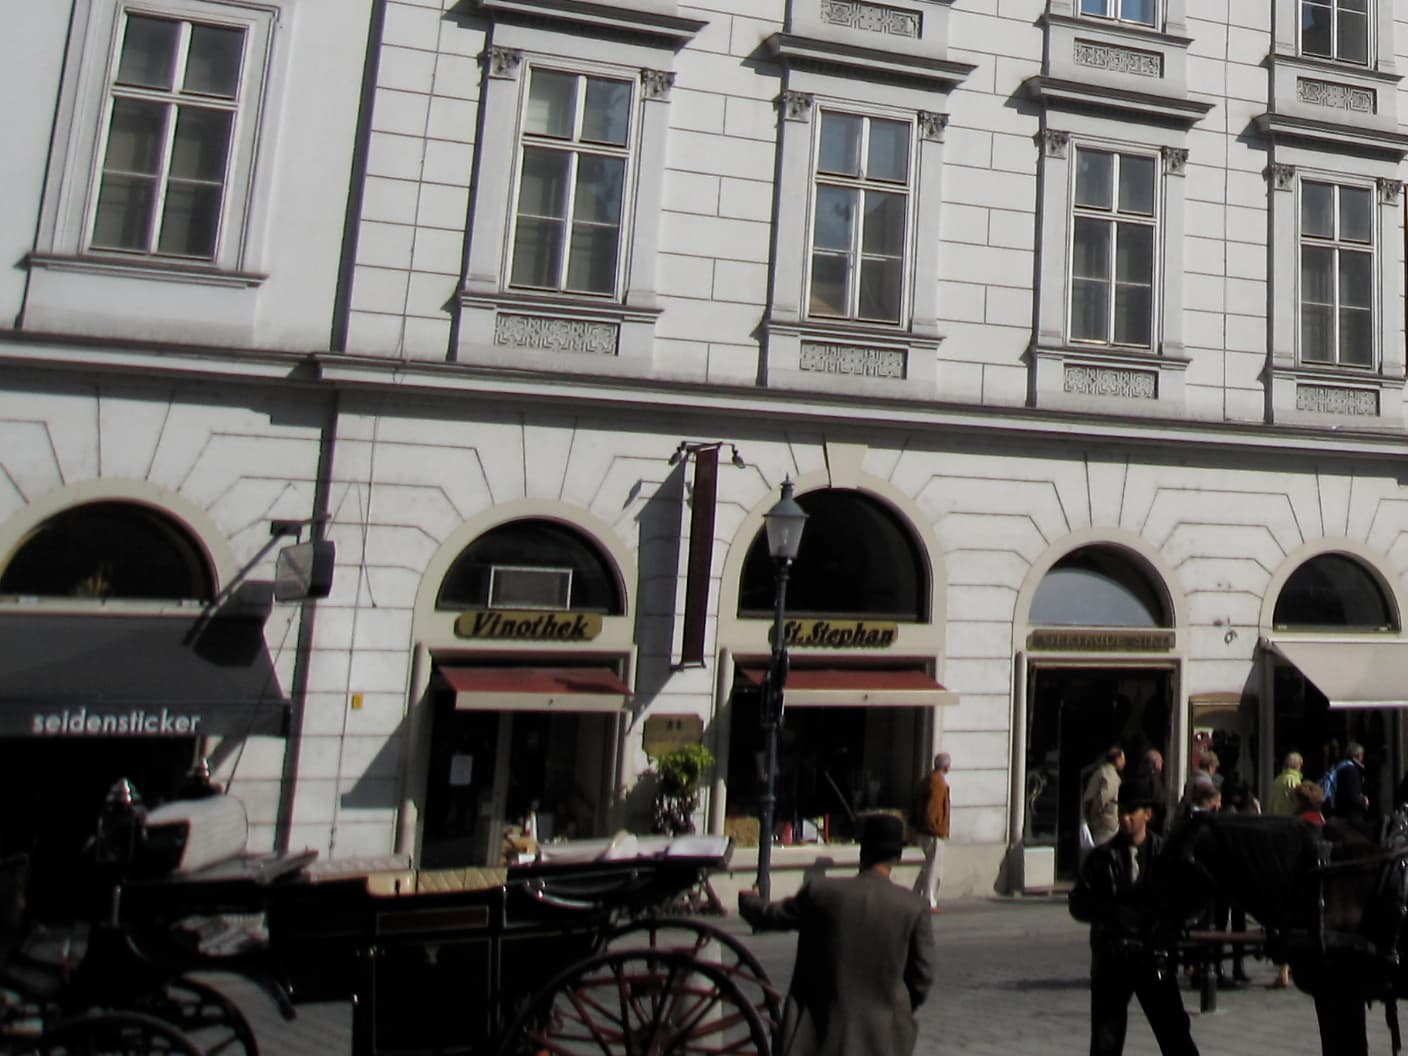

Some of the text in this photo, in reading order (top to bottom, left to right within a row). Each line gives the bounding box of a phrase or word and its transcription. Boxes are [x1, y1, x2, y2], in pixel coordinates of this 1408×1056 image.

[473, 612, 589, 639] Vinothek
[782, 621, 894, 646] St. Stephan
[32, 706, 200, 735] seidensticker
